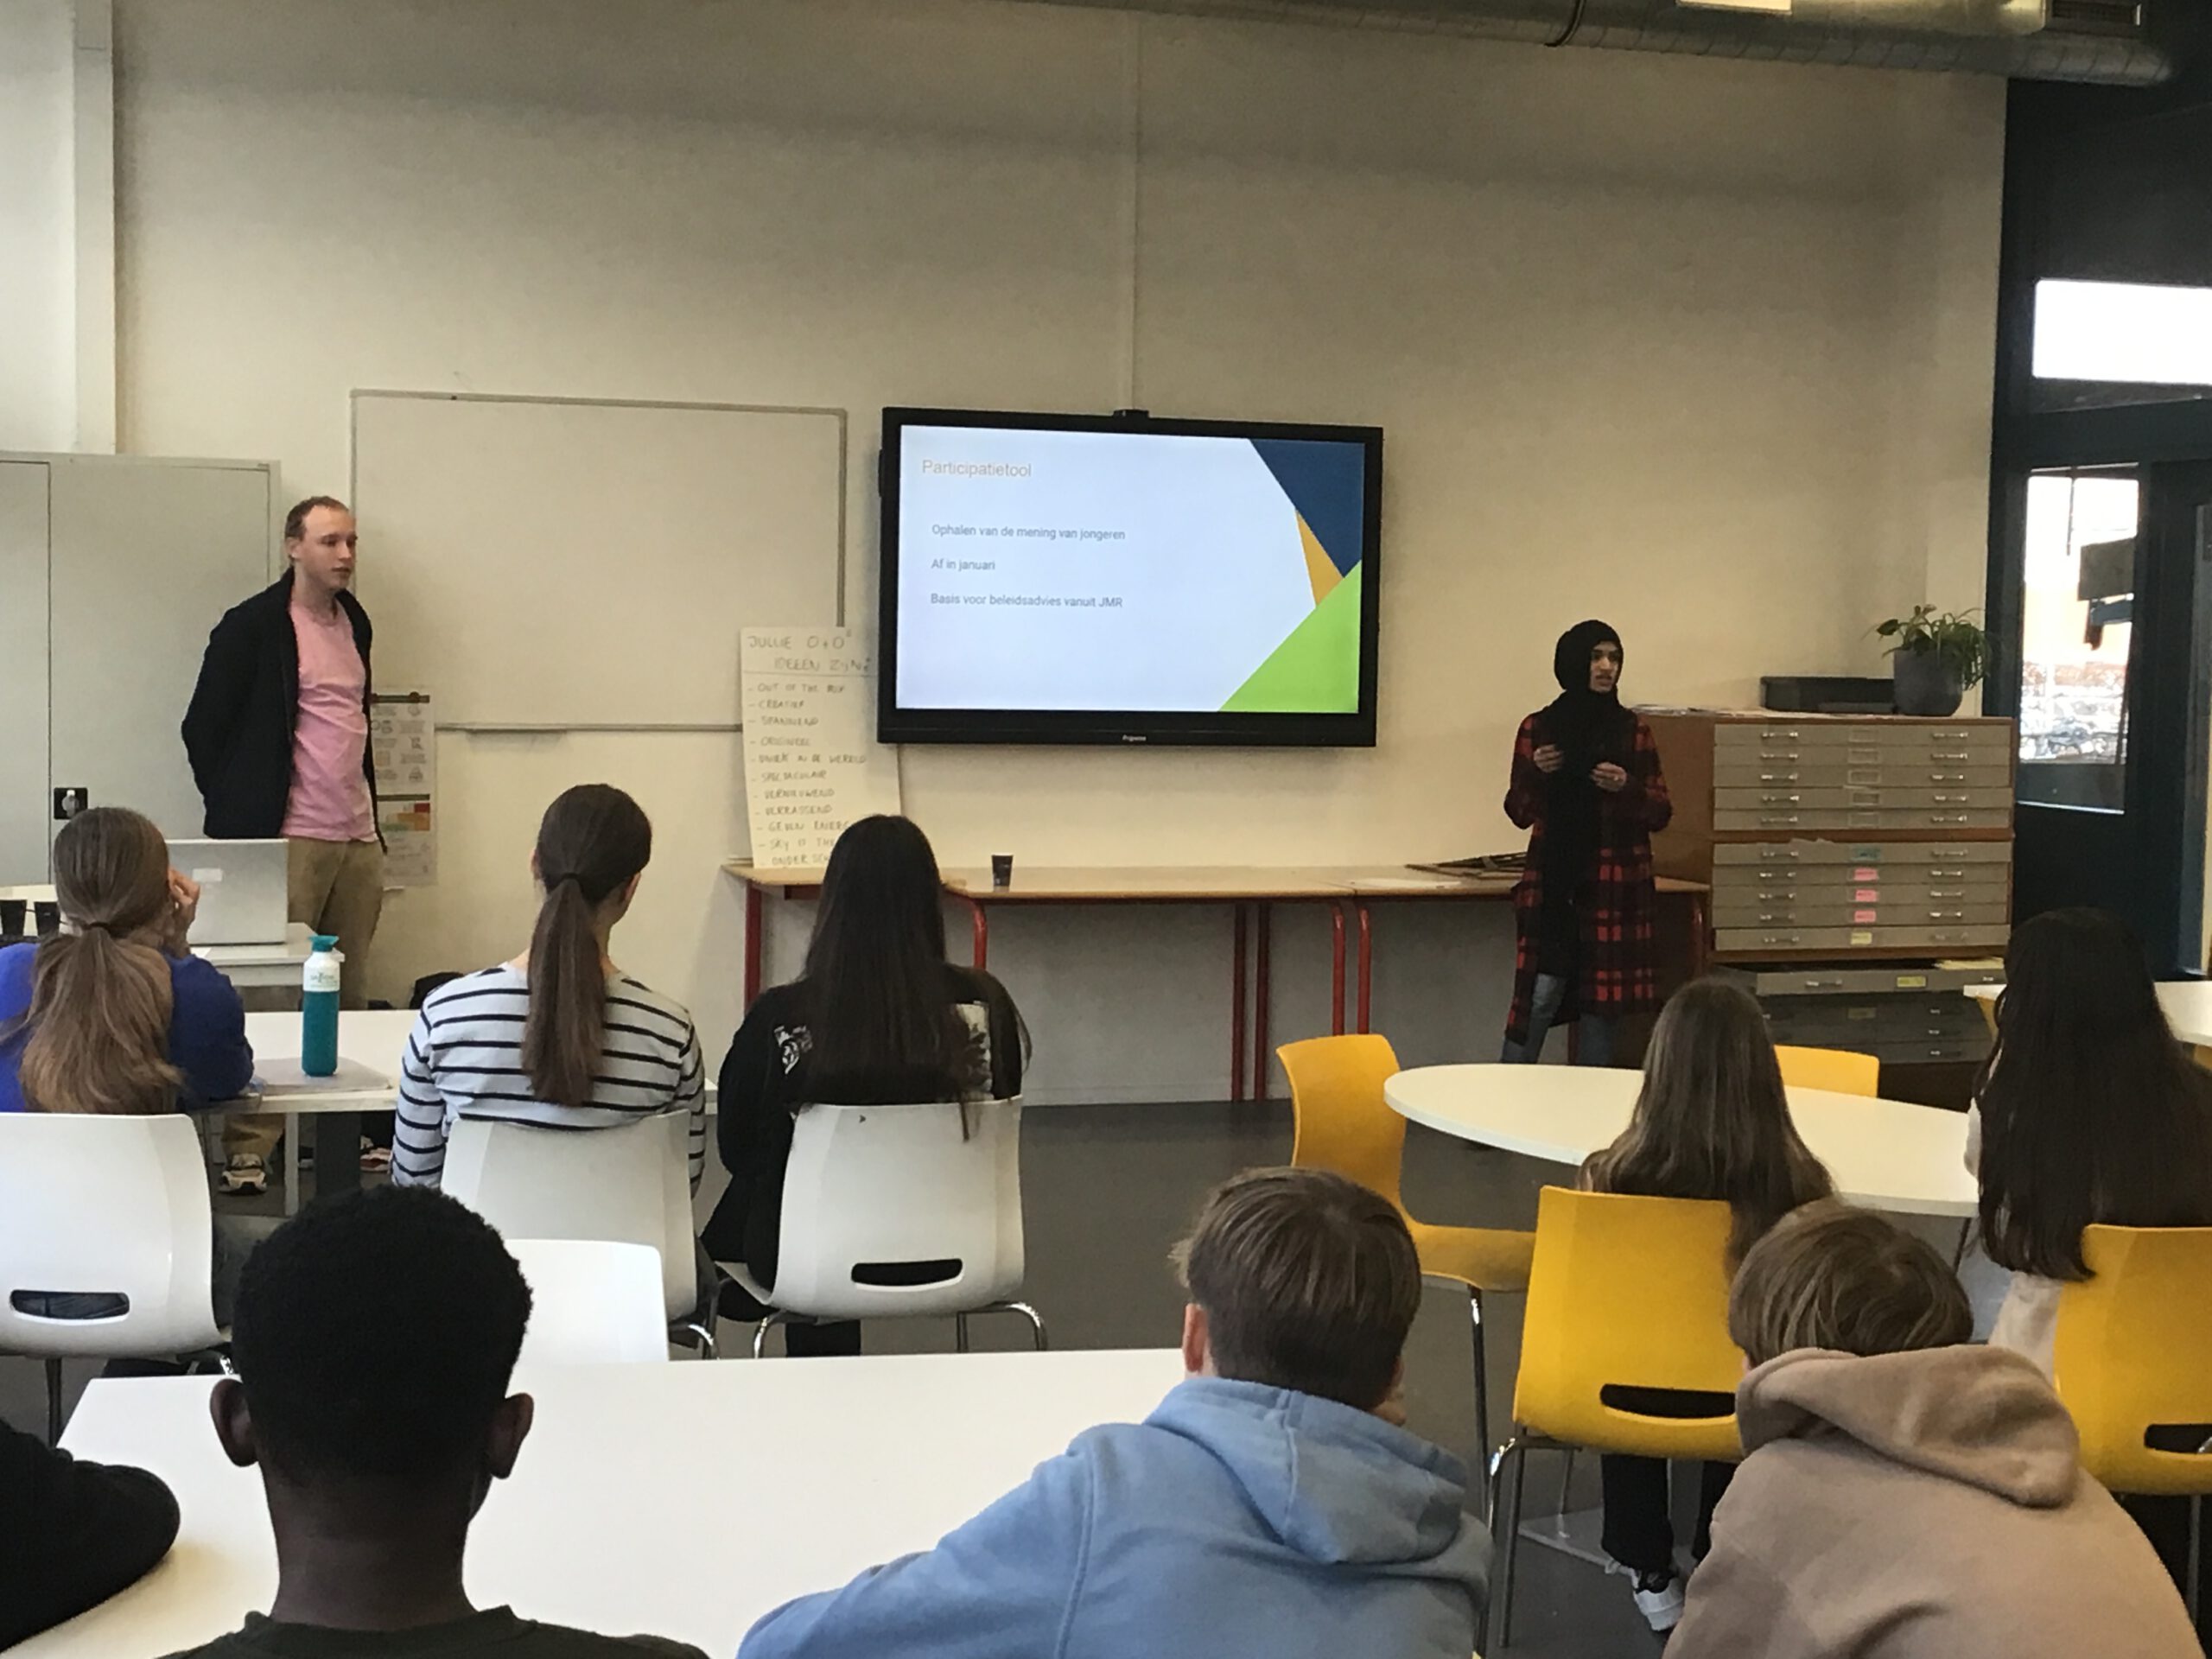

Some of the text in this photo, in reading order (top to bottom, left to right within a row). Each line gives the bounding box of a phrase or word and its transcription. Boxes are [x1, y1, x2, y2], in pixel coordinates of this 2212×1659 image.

[922, 460, 1032, 478] Participatietool
[931, 524, 1125, 541] Ophalen van de mening van jongeren
[931, 558, 995, 572] Af in januari
[931, 593, 1122, 607] Basis voor beleidsadvies vanuit JMR
[747, 635, 791, 649] JULLIE
